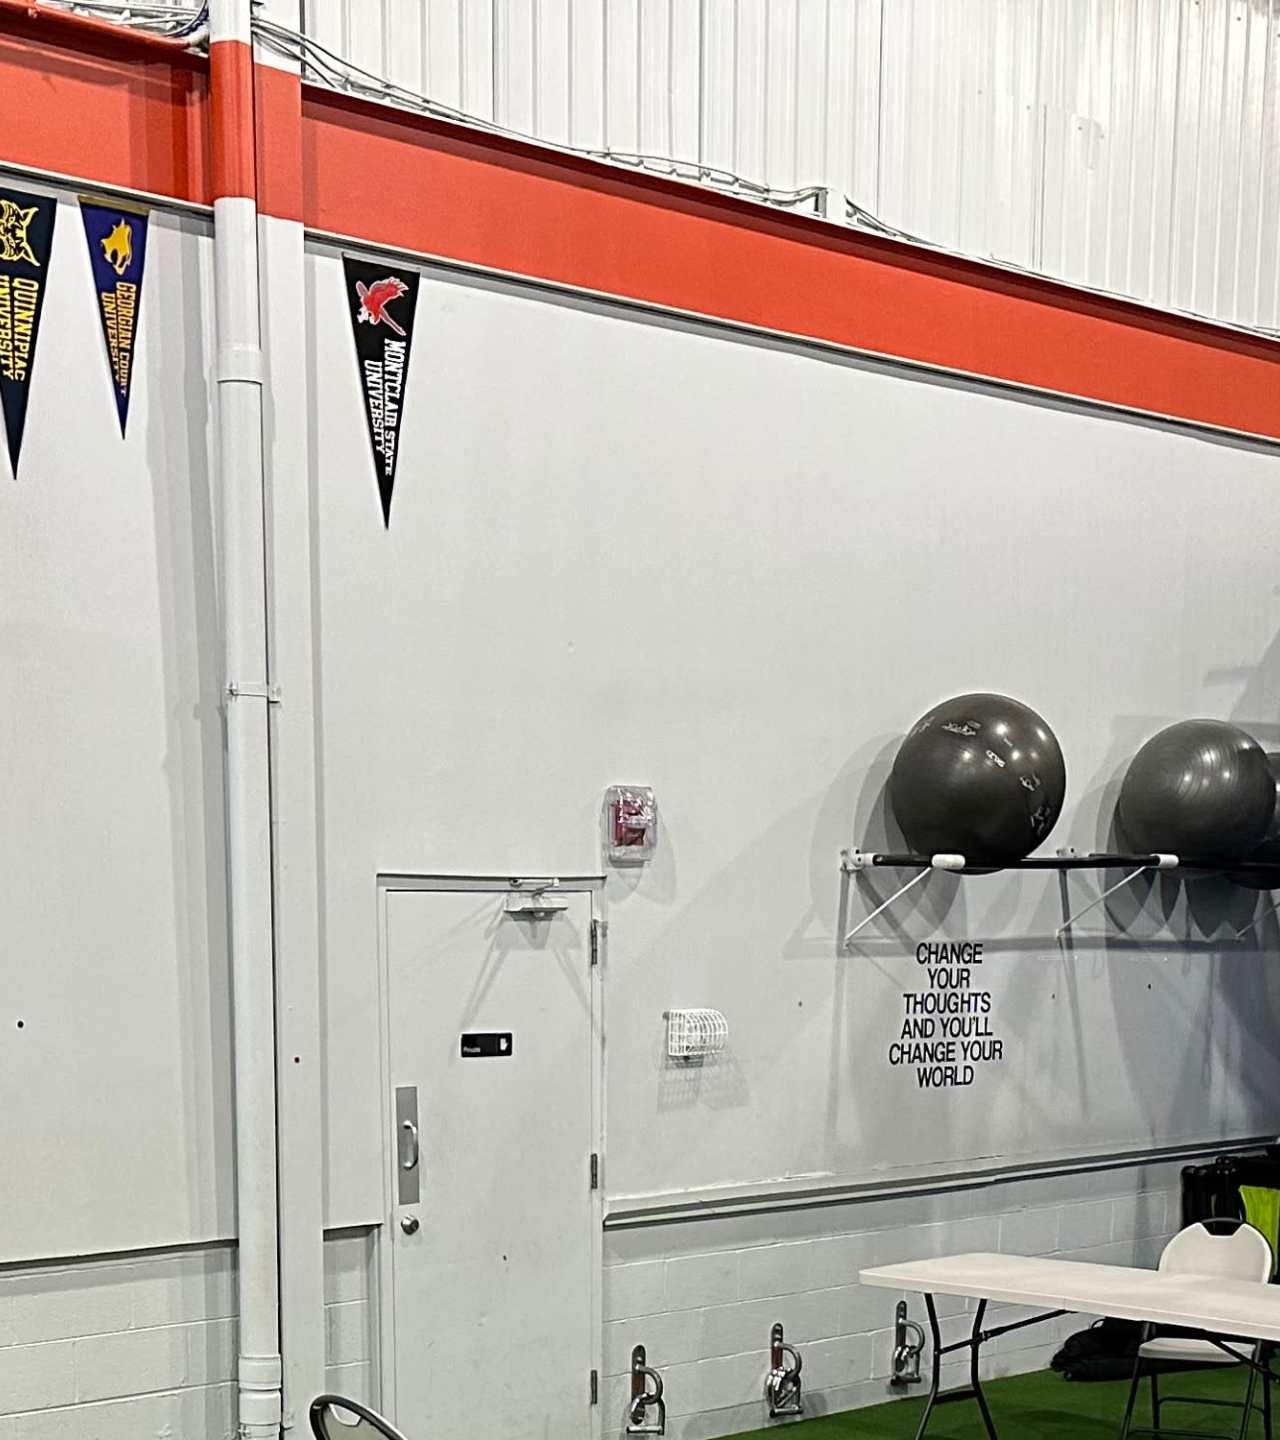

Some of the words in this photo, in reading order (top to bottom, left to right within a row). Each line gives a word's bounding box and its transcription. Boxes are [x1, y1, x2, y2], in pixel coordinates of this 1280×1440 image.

[12, 277, 39, 381] QUINNIPIAC
[101, 291, 120, 383] UNIVERSITY
[116, 281, 136, 350] GEORGIAN
[119, 352, 131, 397] COURT
[384, 338, 406, 427] MONTCLAIR
[364, 359, 385, 455] UNIVERSITY
[384, 429, 396, 476] STATE
[916, 942, 984, 965] CHANGE
[928, 968, 971, 989] YOUR
[903, 992, 991, 1015] THOUGHTS
[901, 1018, 936, 1040] AND
[940, 1016, 993, 1038] YOU'LL
[889, 1042, 956, 1065] CHANGE
[961, 1040, 1003, 1061] YOUR
[917, 1065, 974, 1088] WORLD
